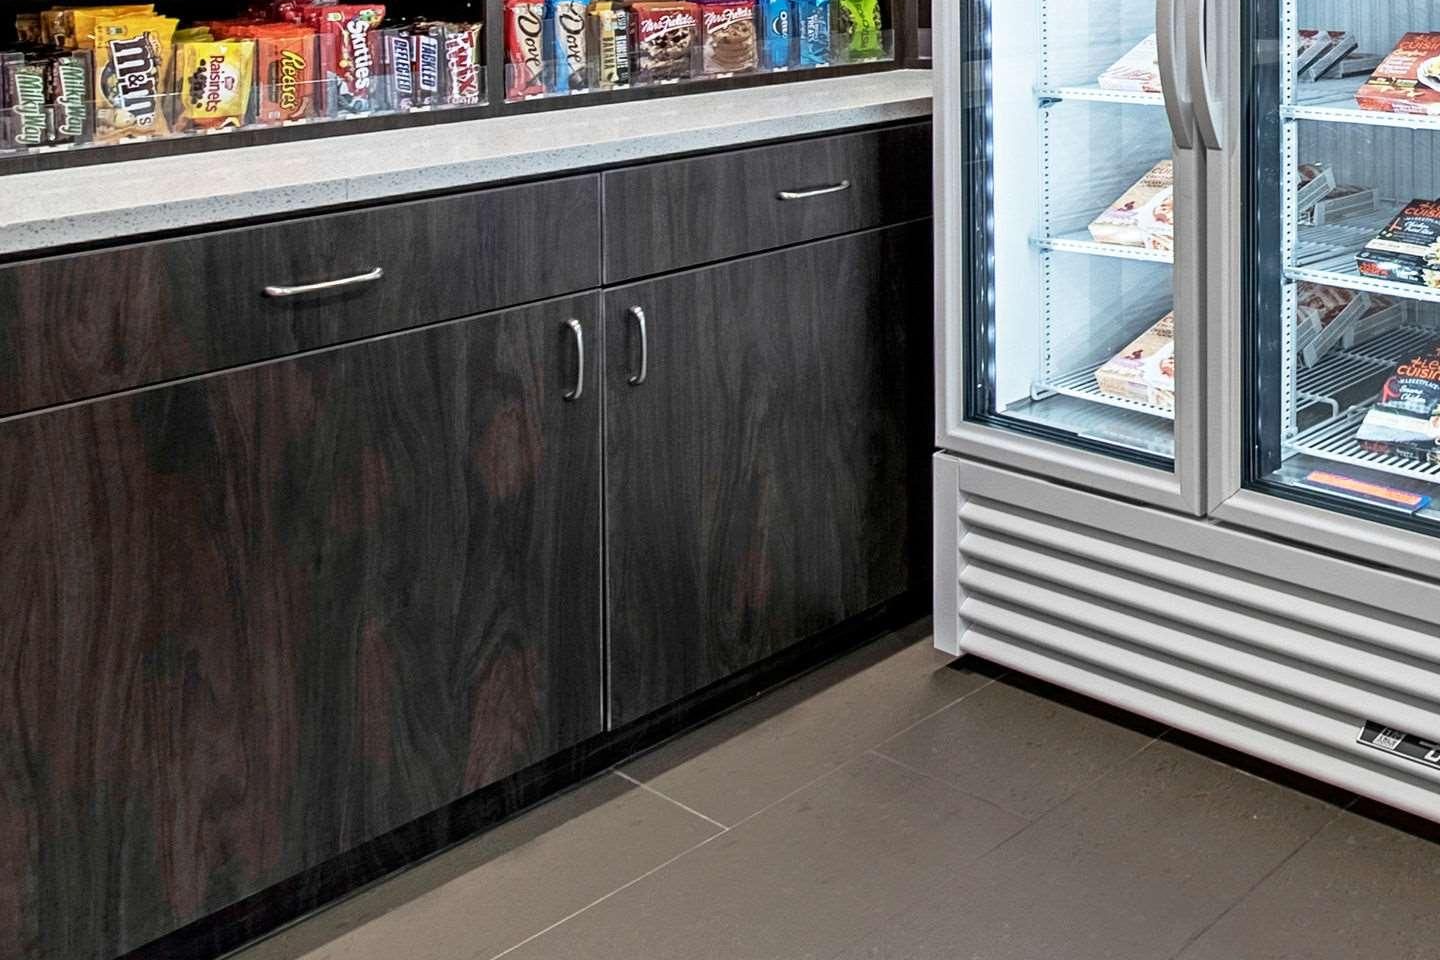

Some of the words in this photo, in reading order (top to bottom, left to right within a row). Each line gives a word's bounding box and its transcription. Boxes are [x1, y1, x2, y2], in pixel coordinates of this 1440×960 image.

[347, 20, 373, 91] Skittles
[421, 38, 437, 90] TACKLED
[517, 4, 542, 68] Dove
[559, 0, 585, 67] Dove
[205, 55, 224, 113] Raisinets
[394, 38, 410, 92] DEFLECTED
